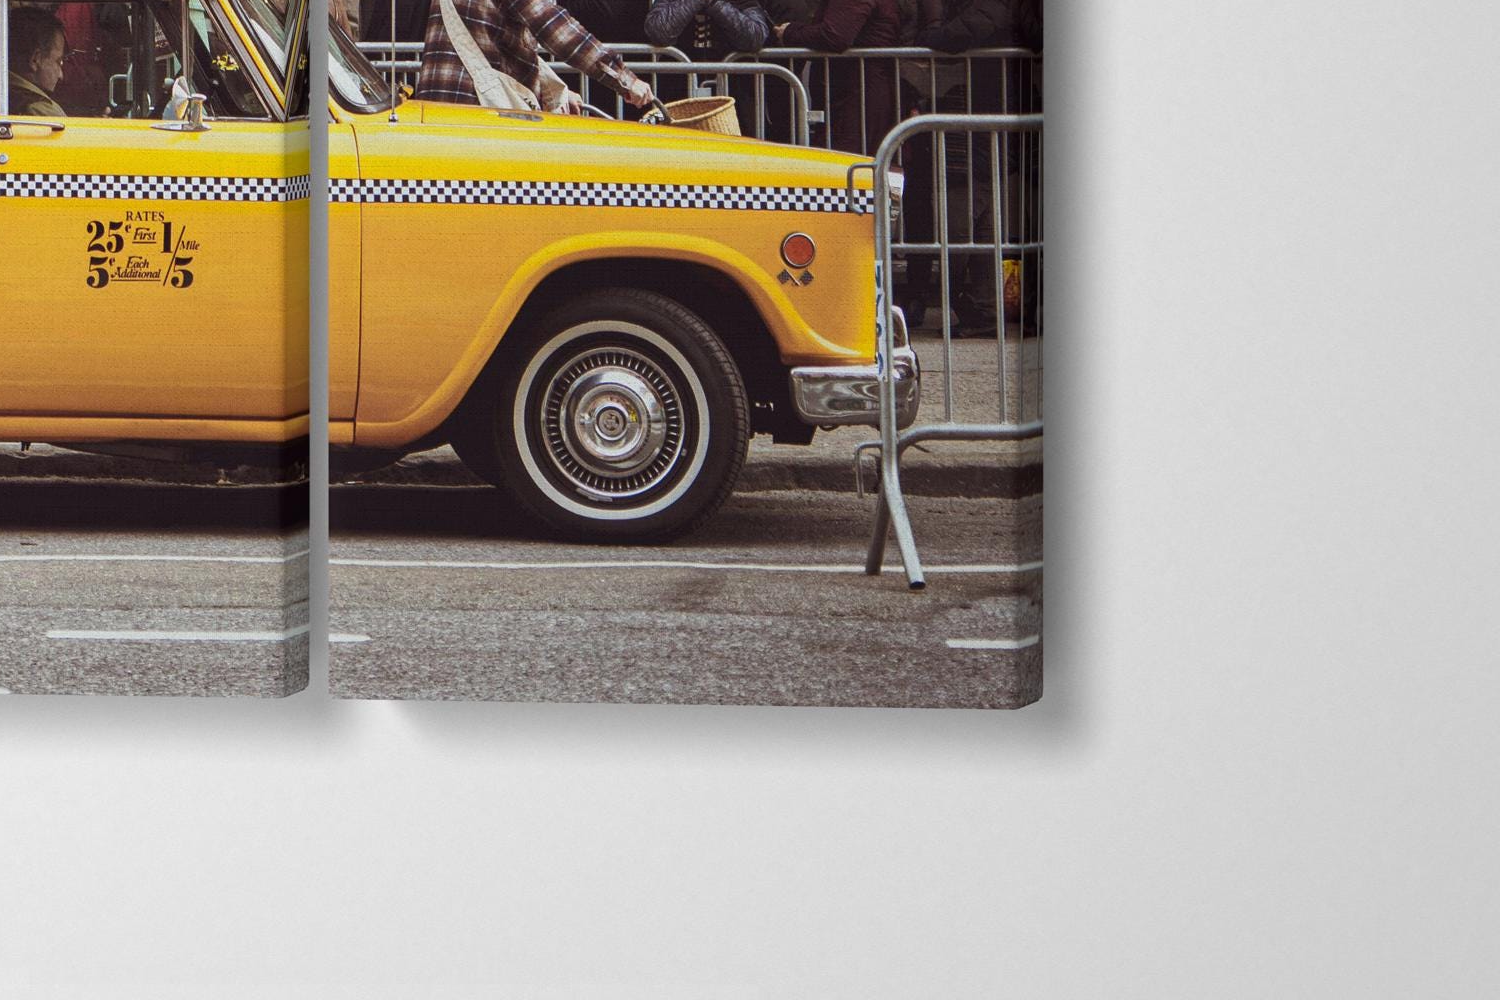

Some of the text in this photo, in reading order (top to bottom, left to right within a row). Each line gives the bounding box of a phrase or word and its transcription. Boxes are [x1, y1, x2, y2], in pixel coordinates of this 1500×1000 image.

[125, 210, 165, 222] RATES
[132, 227, 157, 241] First
[180, 240, 200, 251] Mile
[126, 256, 150, 269] Each
[111, 267, 162, 279] Additional
